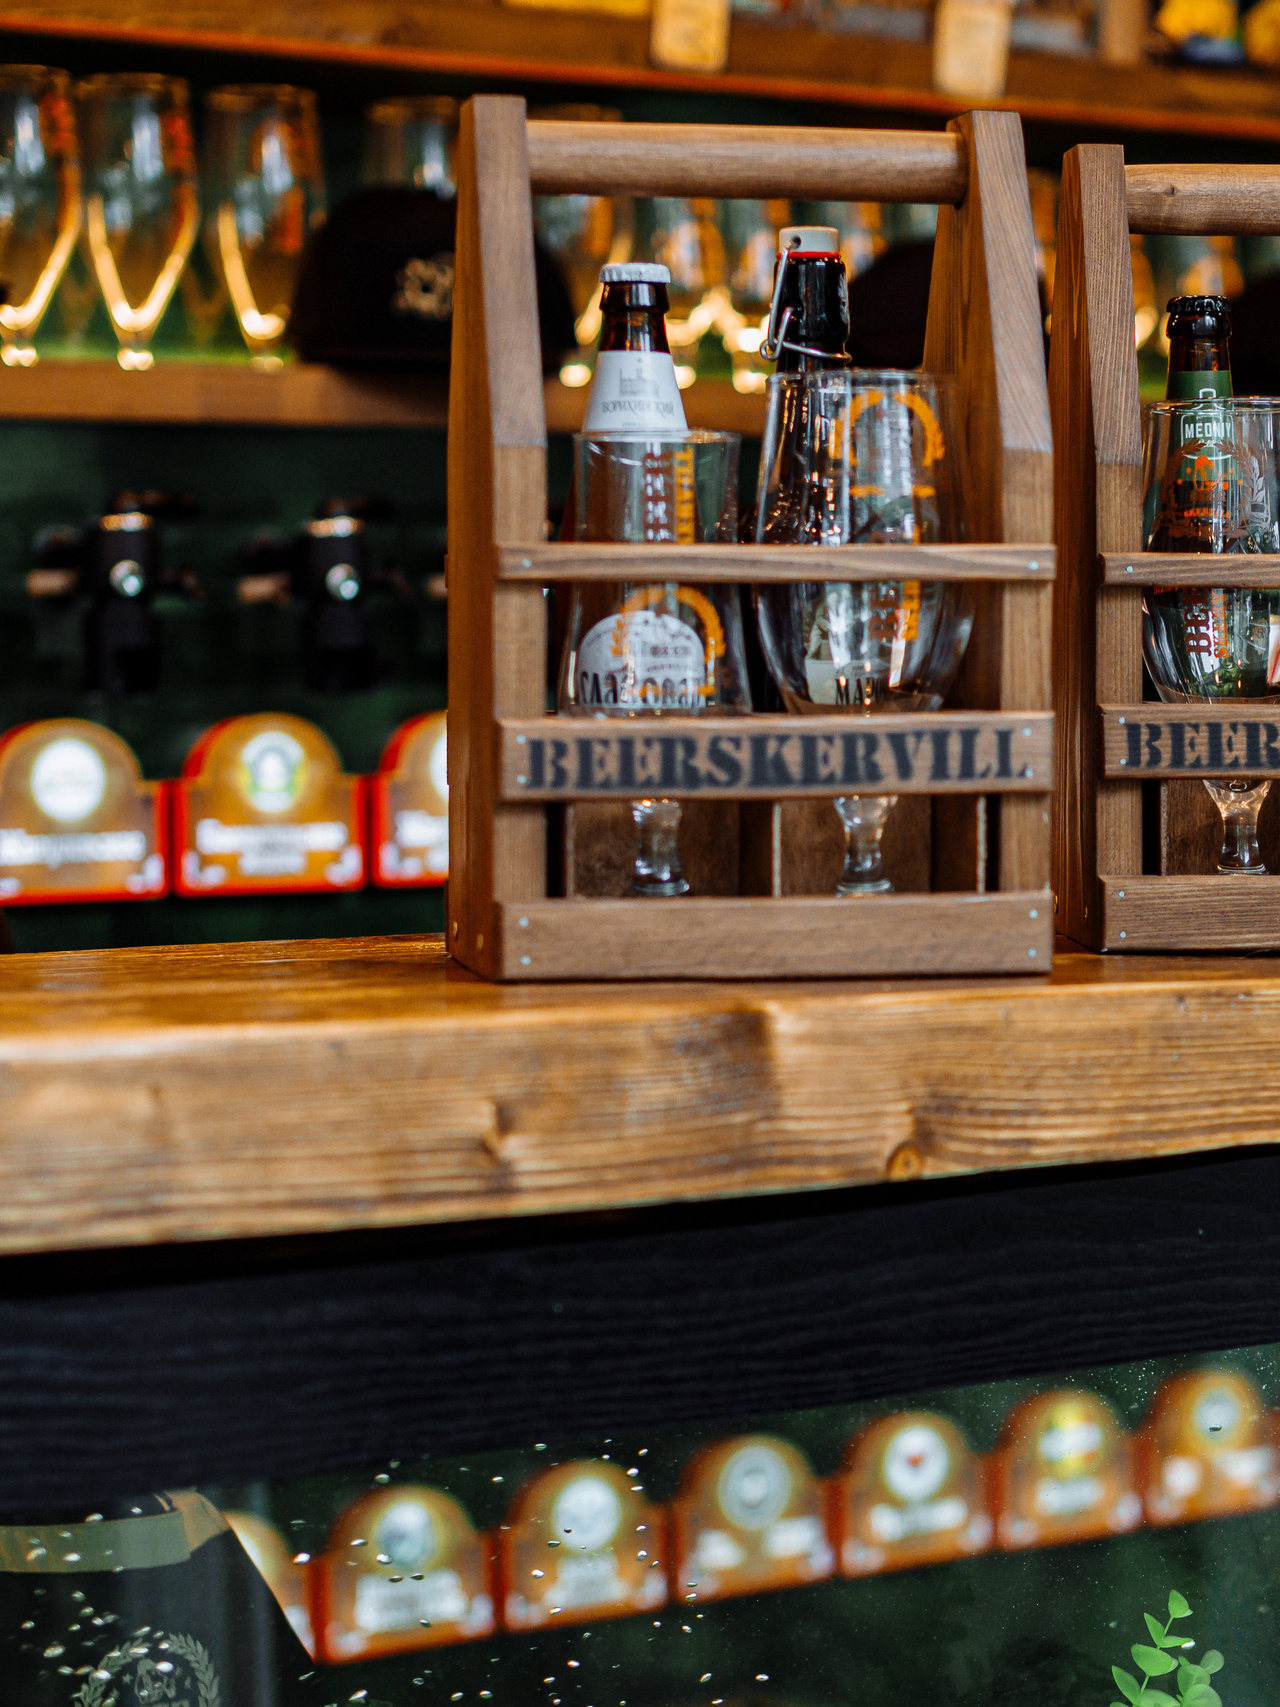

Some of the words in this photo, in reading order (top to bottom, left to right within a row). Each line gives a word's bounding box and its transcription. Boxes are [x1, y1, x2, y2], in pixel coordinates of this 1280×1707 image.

[1185, 421, 1232, 439] MEDNIY
[1211, 587, 1229, 659] SKERV
[526, 728, 1027, 791] BEERSKERVILL
